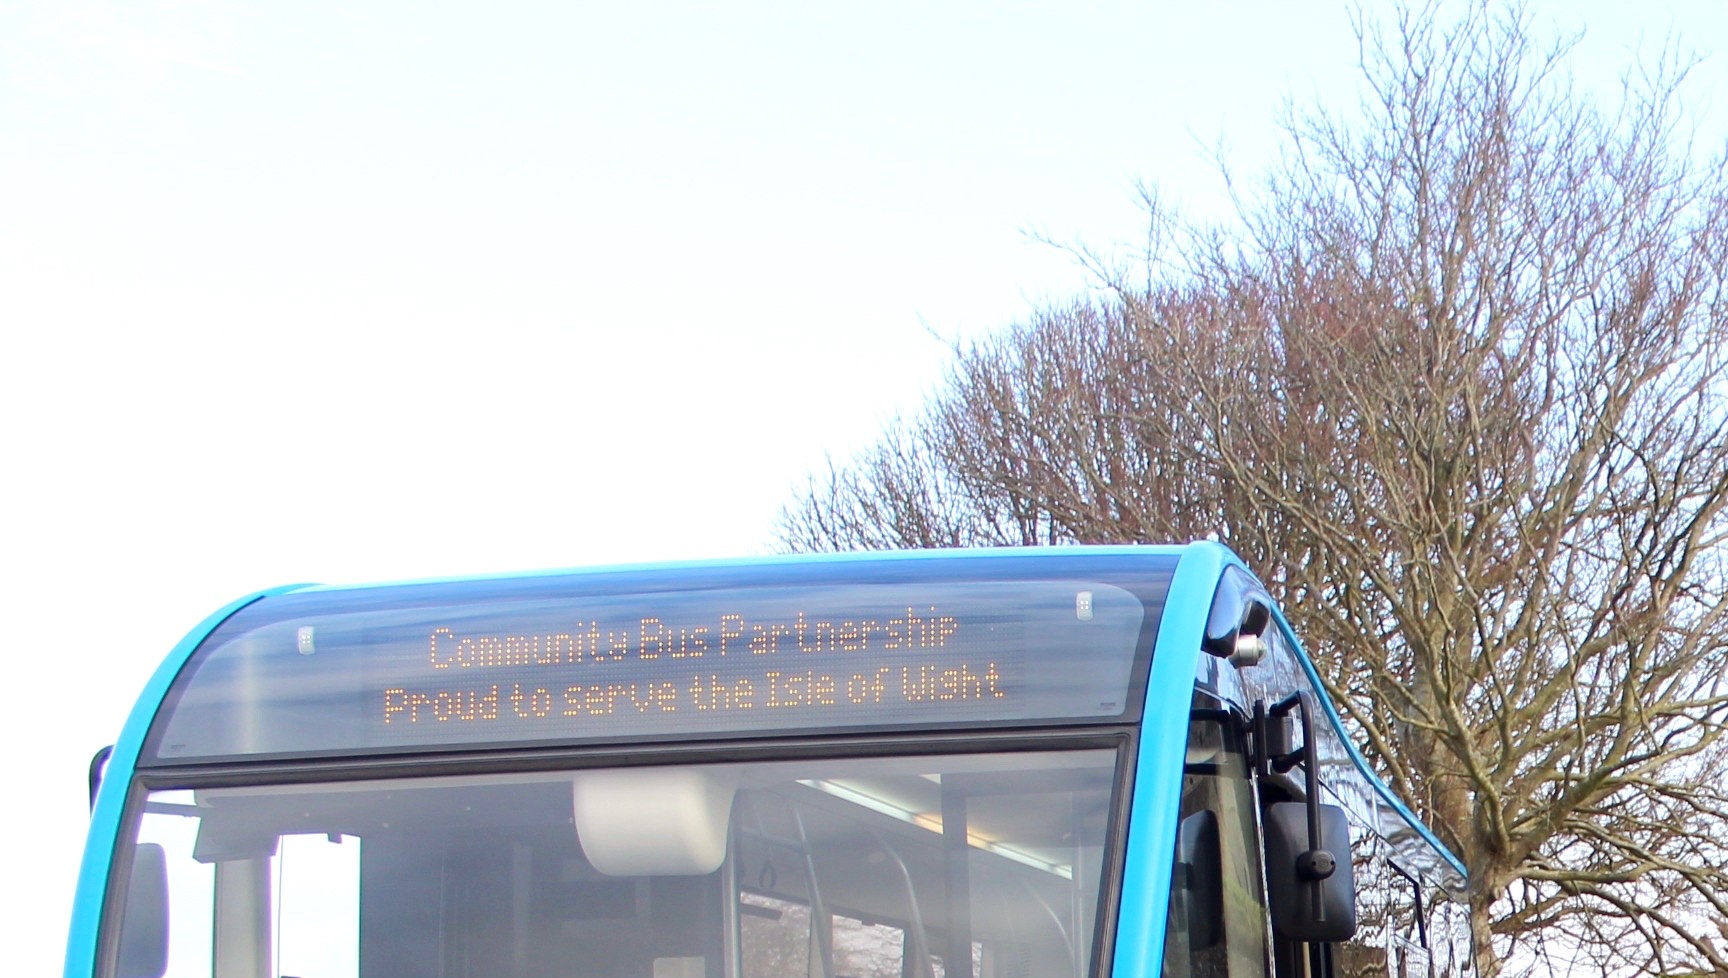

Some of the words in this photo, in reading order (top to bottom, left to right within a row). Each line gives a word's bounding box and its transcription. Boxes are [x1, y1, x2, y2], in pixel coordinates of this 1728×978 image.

[430, 620, 628, 669] Community
[639, 617, 709, 659] Bus
[720, 605, 959, 657] Partnership
[384, 683, 498, 724] Proud
[509, 682, 551, 718] to
[562, 681, 677, 716] serve
[688, 672, 753, 710] the
[765, 669, 836, 707] Isle
[847, 666, 890, 704] of
[902, 661, 1005, 701] Wight
